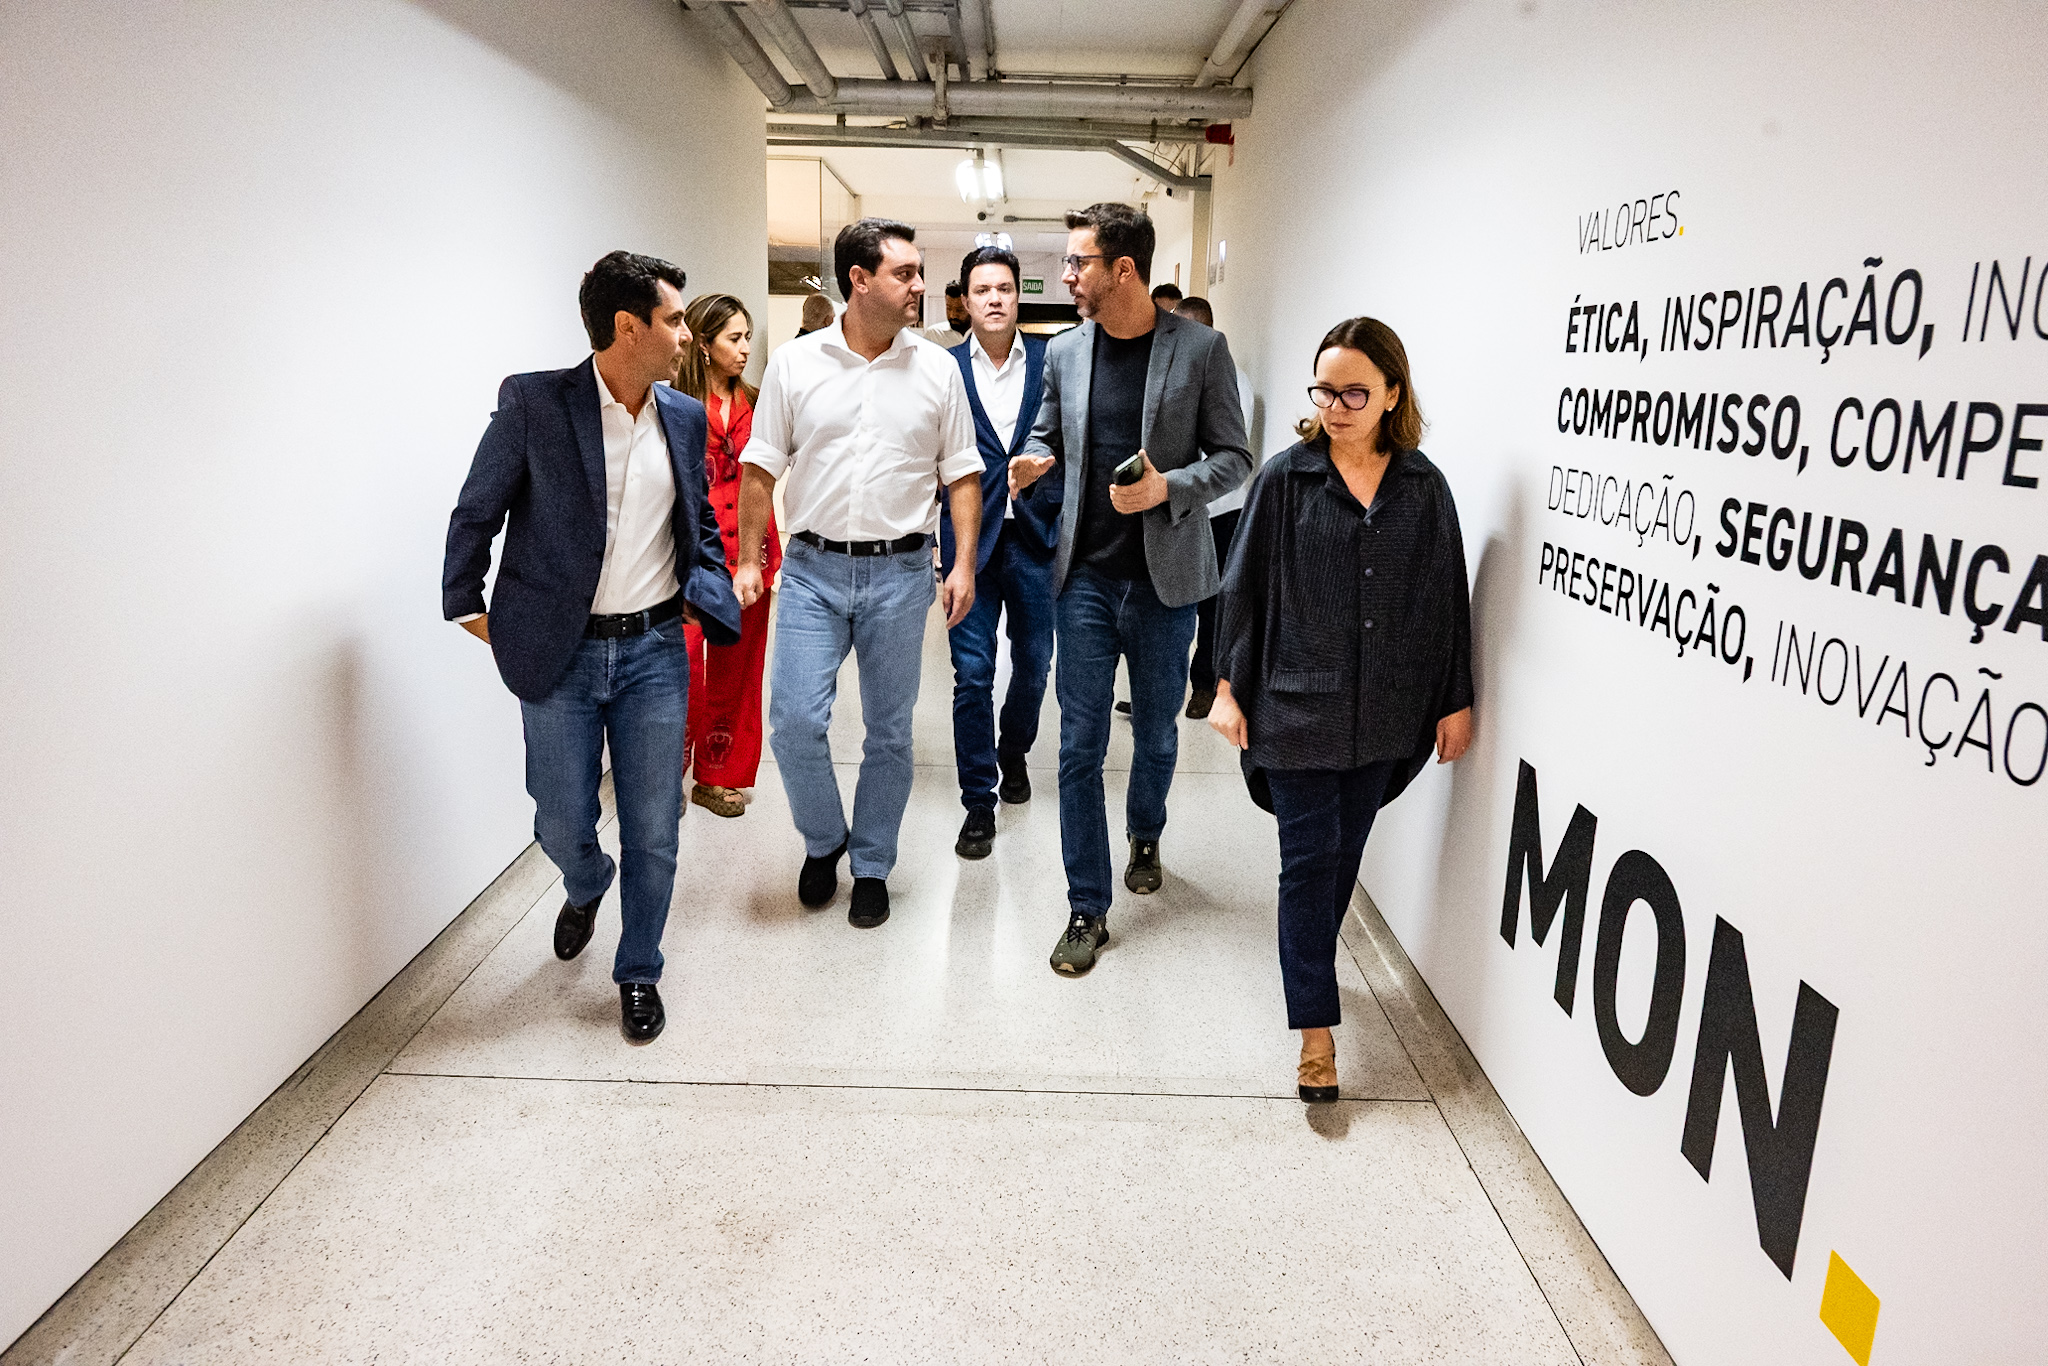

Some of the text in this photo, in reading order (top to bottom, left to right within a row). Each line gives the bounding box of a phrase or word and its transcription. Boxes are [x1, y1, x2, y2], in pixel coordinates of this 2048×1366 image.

[1578, 190, 1684, 255] VALORES.
[1565, 294, 1649, 364] ÉTICA,
[1660, 256, 1936, 365] INSPIRAÇÃO,
[1557, 386, 2048, 490] COMPROMISSO, COMPE
[1547, 465, 2048, 645] DEDICAÇÃO, SEGURANÇA
[1538, 541, 2048, 788] PRESERVAÇÃO, INOVAÇÃO
